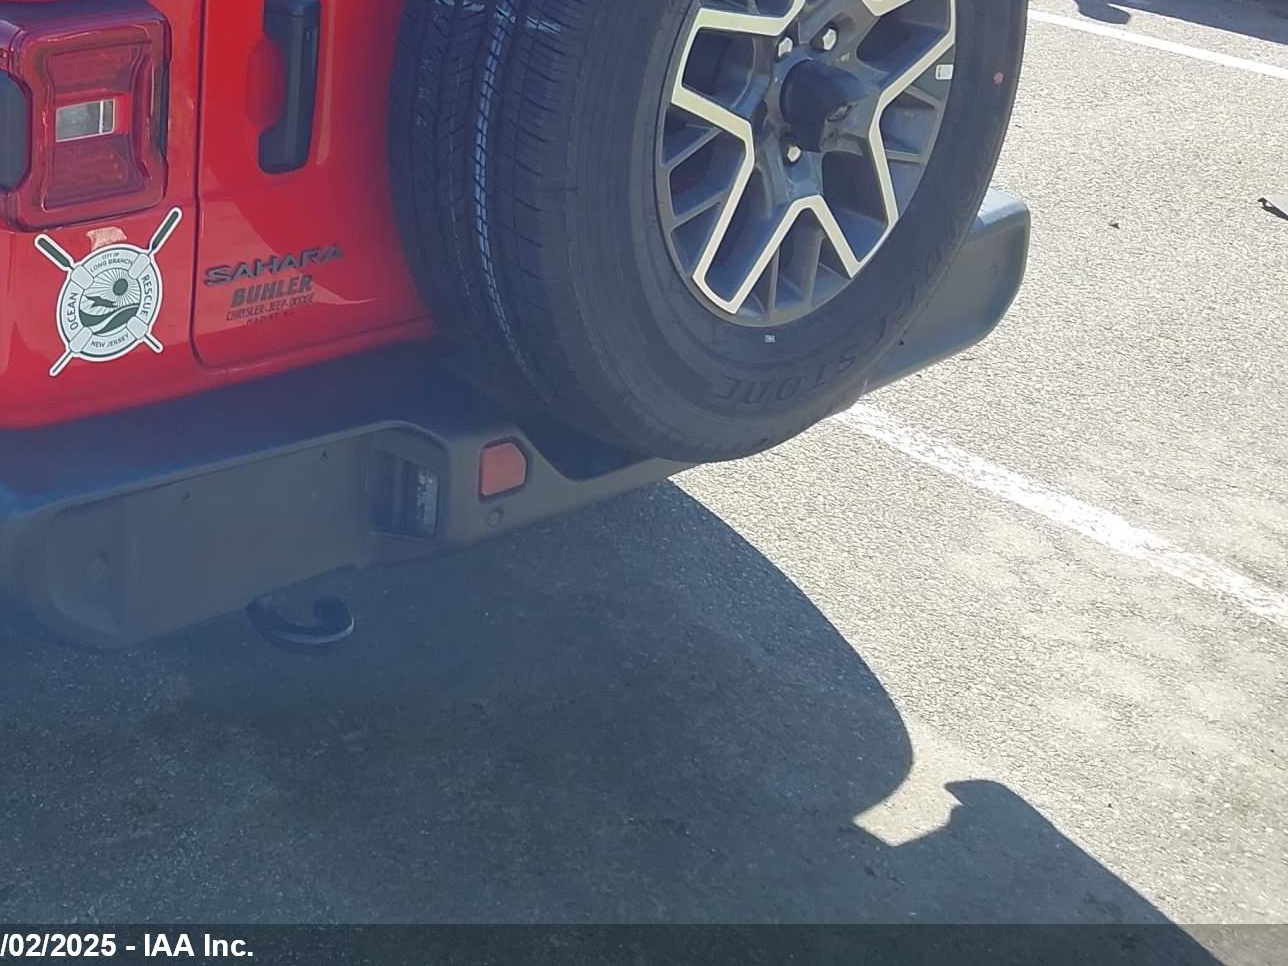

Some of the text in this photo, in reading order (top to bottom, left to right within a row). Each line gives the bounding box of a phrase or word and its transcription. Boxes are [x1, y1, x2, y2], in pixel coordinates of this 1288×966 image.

[89, 257, 133, 273] LONG BRANCH
[204, 244, 344, 287] SAHARA
[67, 292, 79, 331] OCEAN
[141, 274, 153, 317] RESCUE
[90, 333, 130, 348] NEW JERSEY
